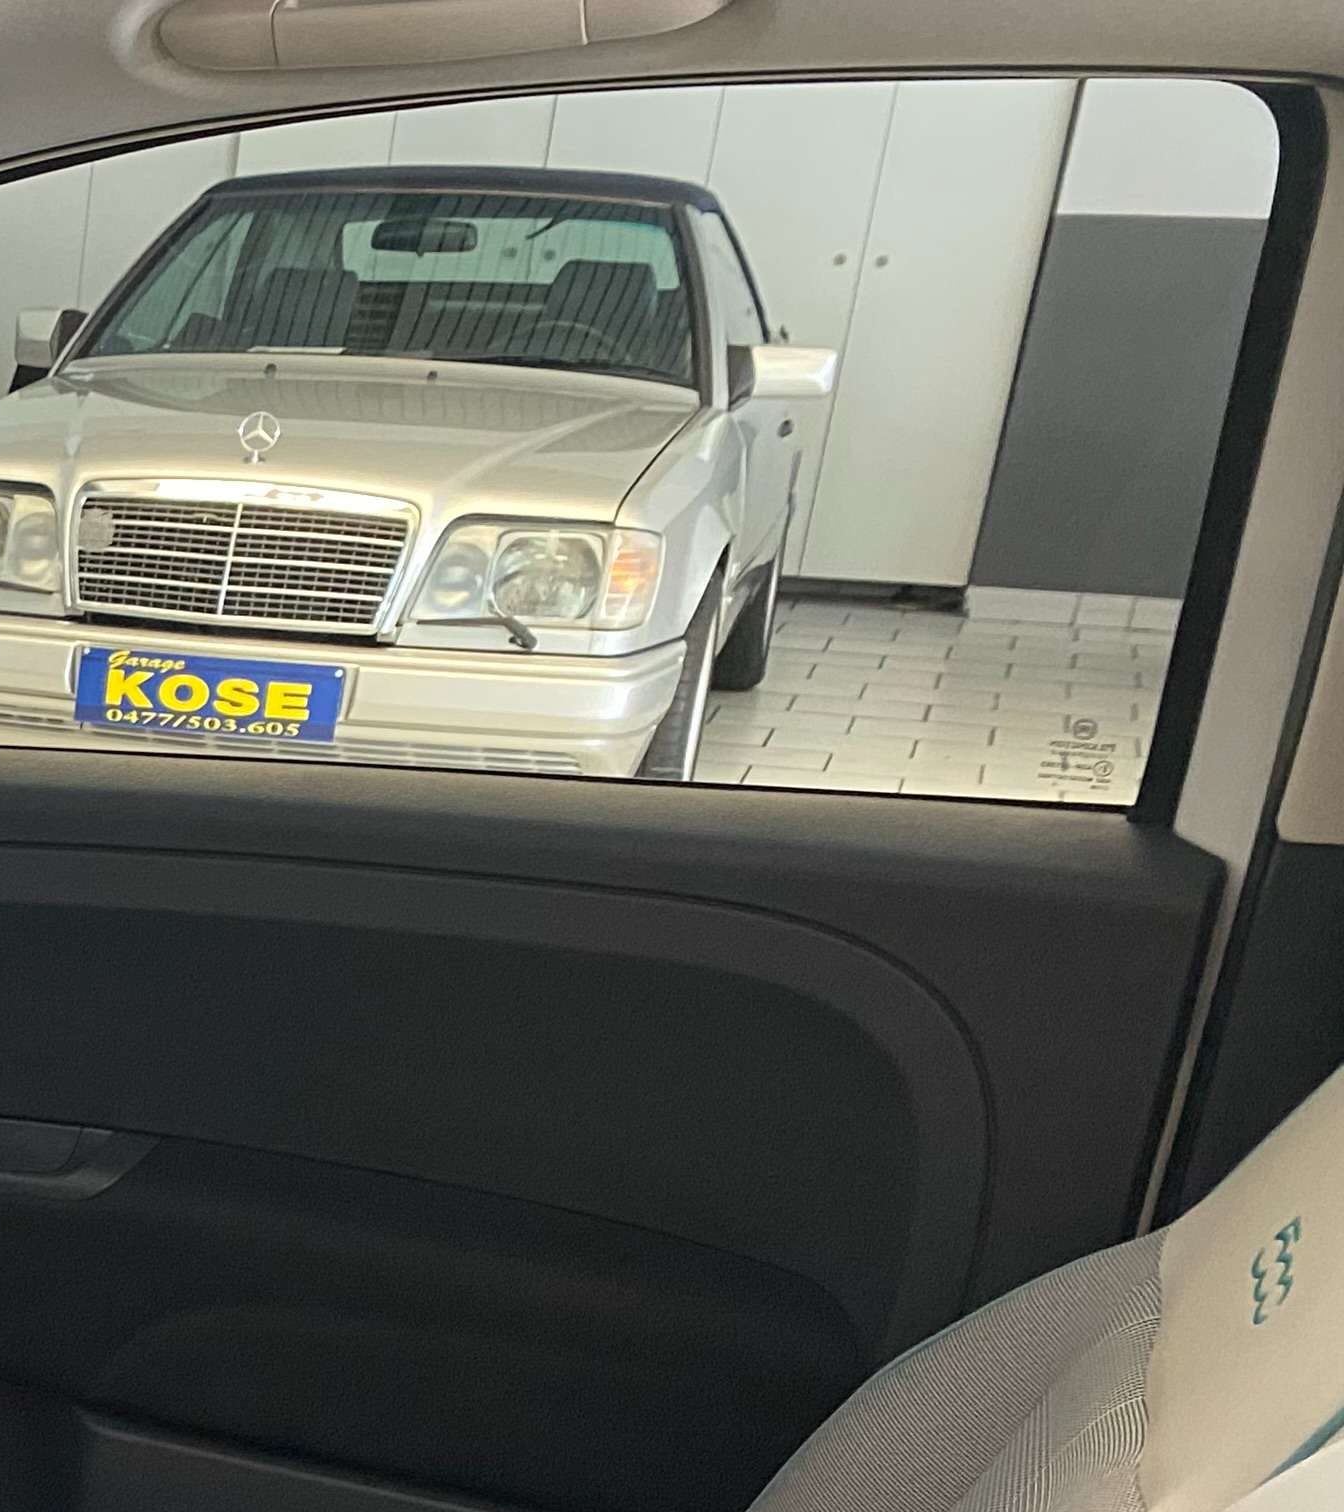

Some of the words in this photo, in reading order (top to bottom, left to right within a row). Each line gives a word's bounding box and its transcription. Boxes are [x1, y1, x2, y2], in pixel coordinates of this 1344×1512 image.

[109, 650, 186, 673] Garage
[105, 669, 312, 721] KOSE
[106, 708, 301, 737] 0477/503.605
